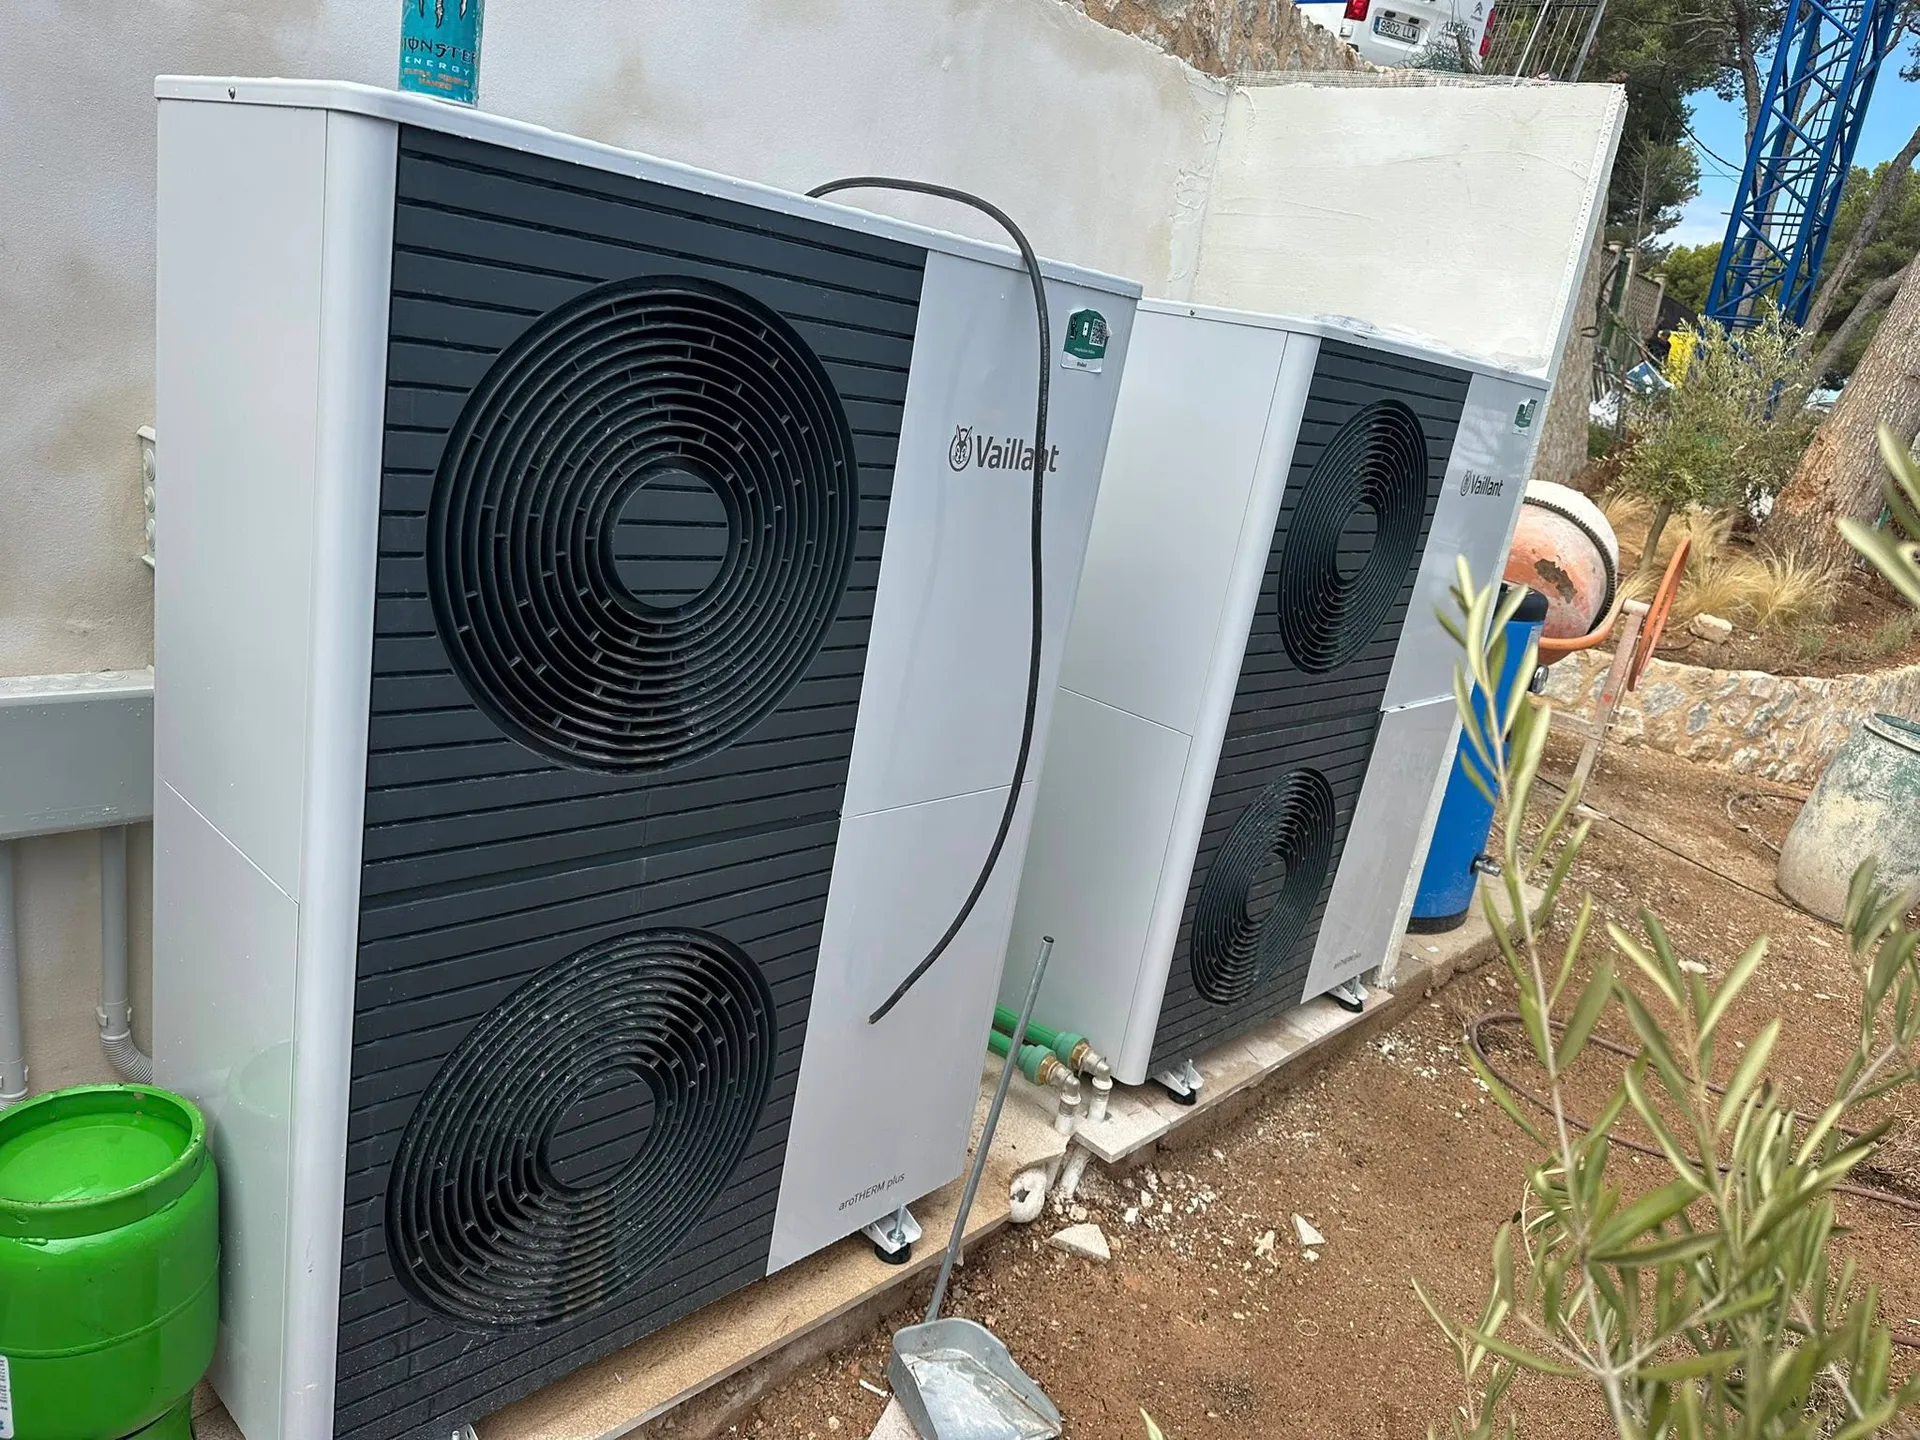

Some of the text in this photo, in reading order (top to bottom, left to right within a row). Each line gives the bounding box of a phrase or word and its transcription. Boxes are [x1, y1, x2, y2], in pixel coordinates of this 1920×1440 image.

[1380, 20, 1400, 35] 9802
[404, 56, 470, 76] ENERGY
[1470, 474, 1504, 497] Vaillant
[838, 1173, 905, 1211] aroTHERM plus
